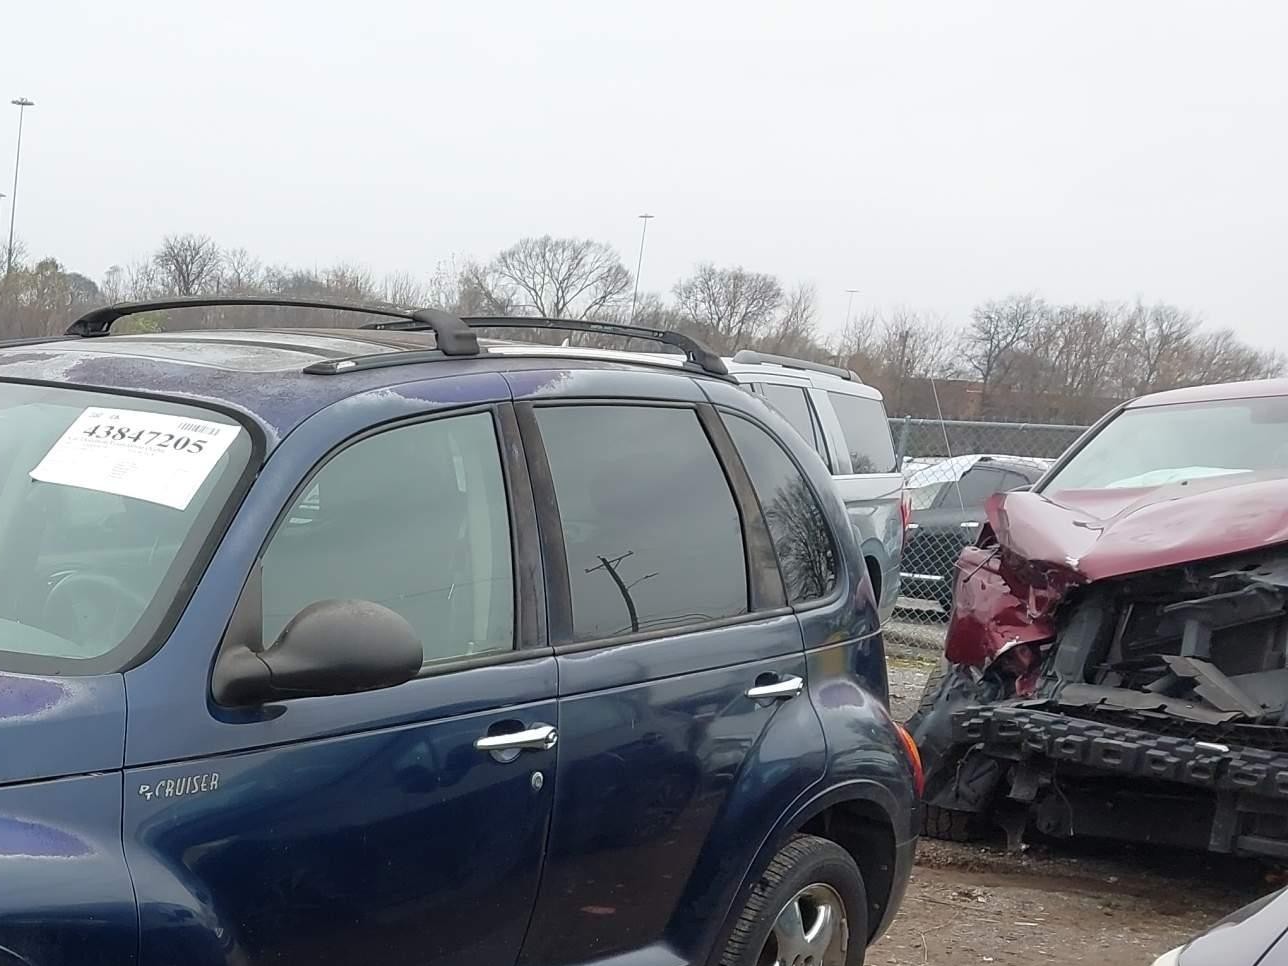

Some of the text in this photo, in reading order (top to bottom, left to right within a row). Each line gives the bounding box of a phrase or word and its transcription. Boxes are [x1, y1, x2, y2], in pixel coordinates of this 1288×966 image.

[83, 424, 208, 454] 43847205
[139, 772, 219, 800] PT CRUISER
